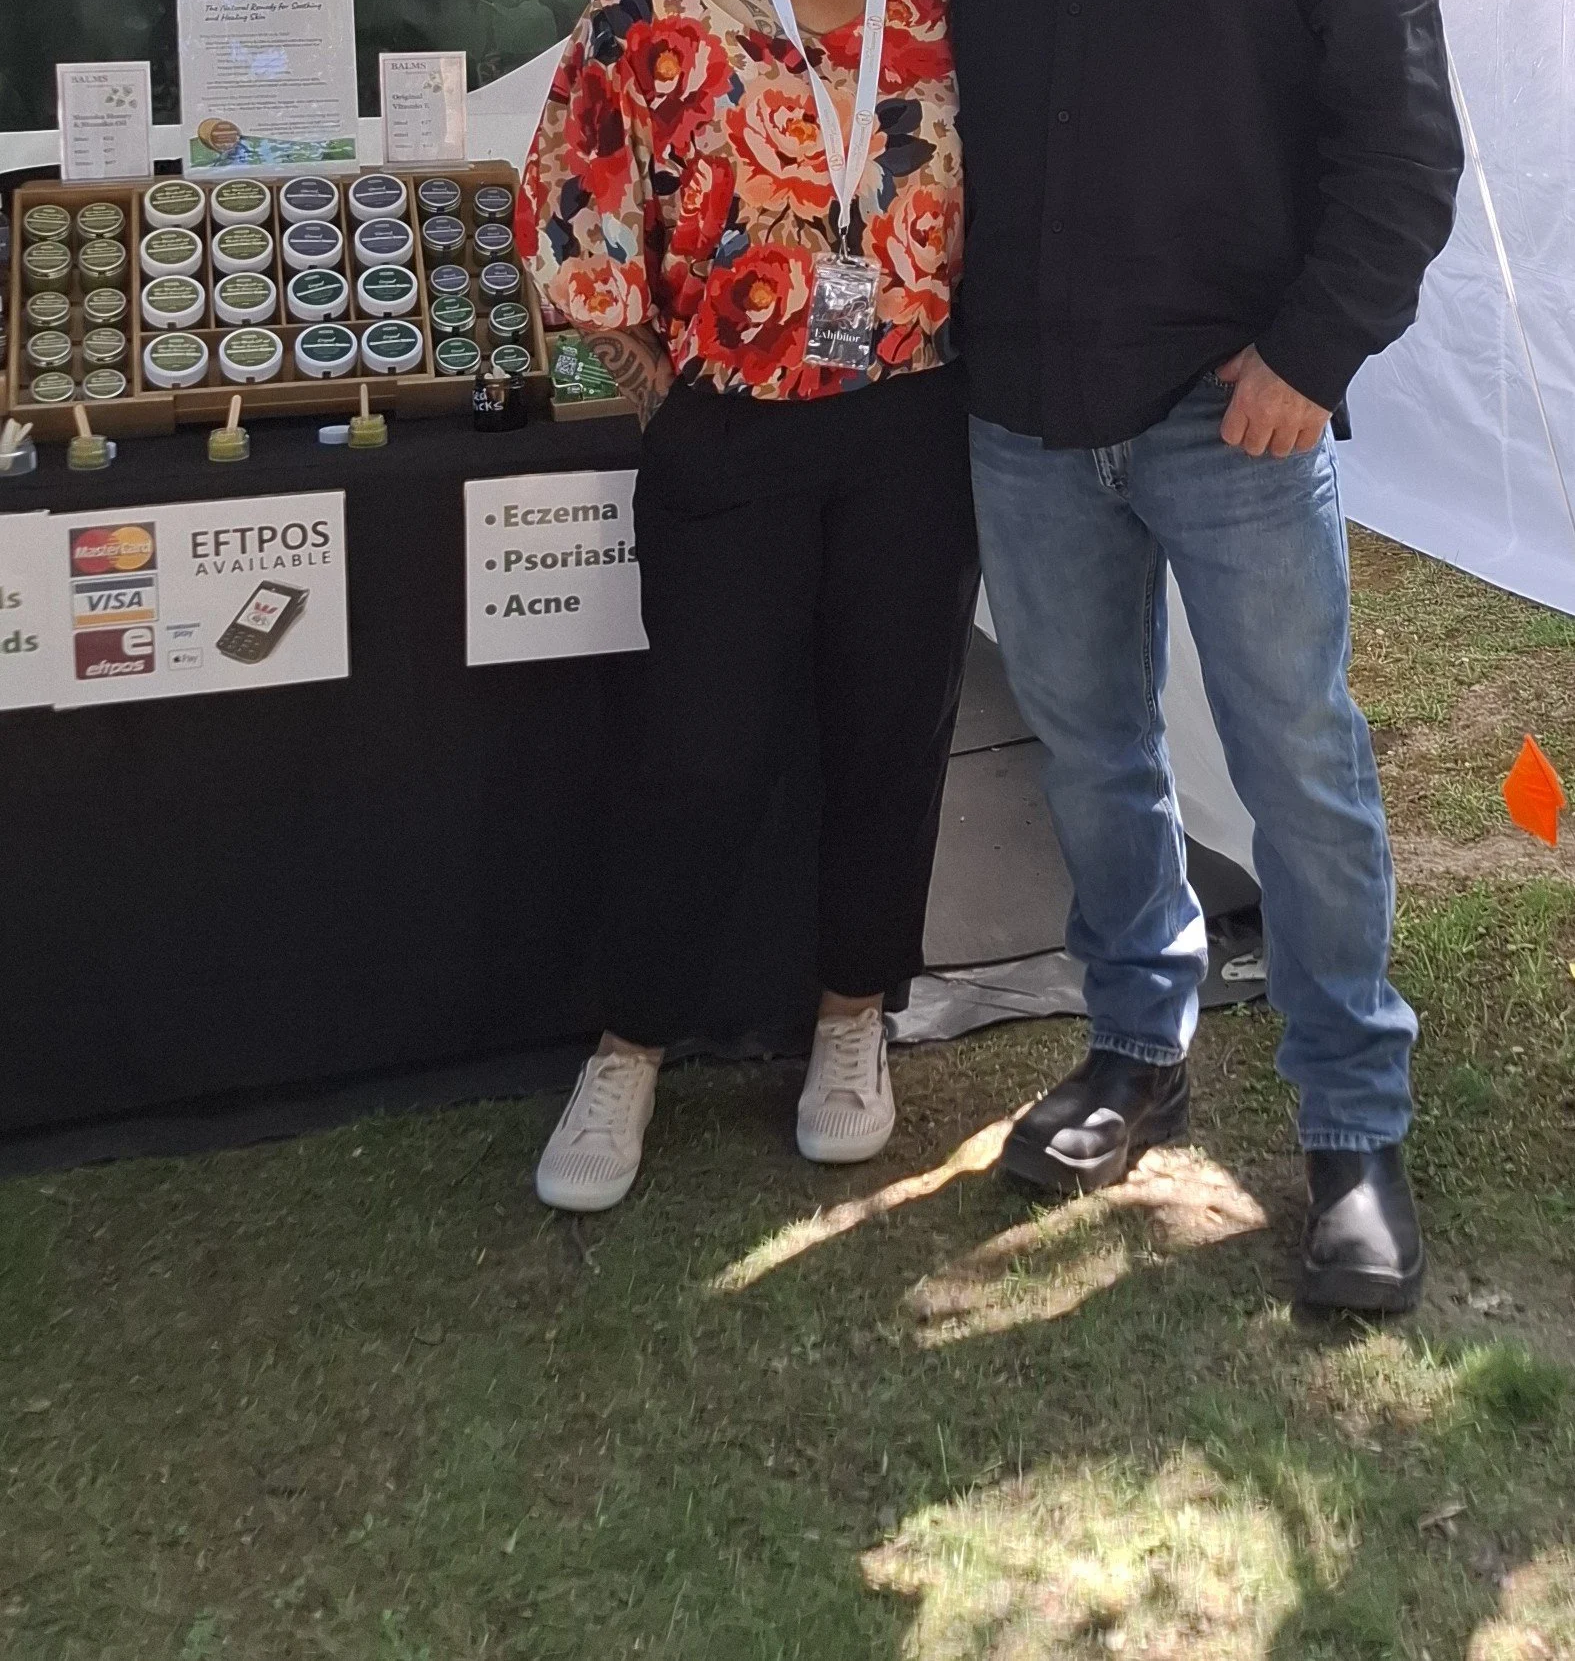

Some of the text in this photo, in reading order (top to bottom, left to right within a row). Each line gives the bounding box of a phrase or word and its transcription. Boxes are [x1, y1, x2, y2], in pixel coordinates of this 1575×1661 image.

[206, 1, 322, 12] The Natural Remedy for Soothing
[220, 14, 248, 23] Healing
[250, 12, 266, 21] Skin
[391, 62, 427, 70] BALMS
[815, 328, 861, 343] Exhibitor
[503, 503, 619, 528] Eczema
[191, 520, 331, 559] EFTPOS
[74, 542, 152, 559] MasterCard
[503, 540, 639, 573] Psoriasis
[195, 550, 332, 576] AVAILABLE
[87, 590, 144, 612] VISA
[502, 593, 581, 618] Acne
[85, 658, 145, 676] eftpos
